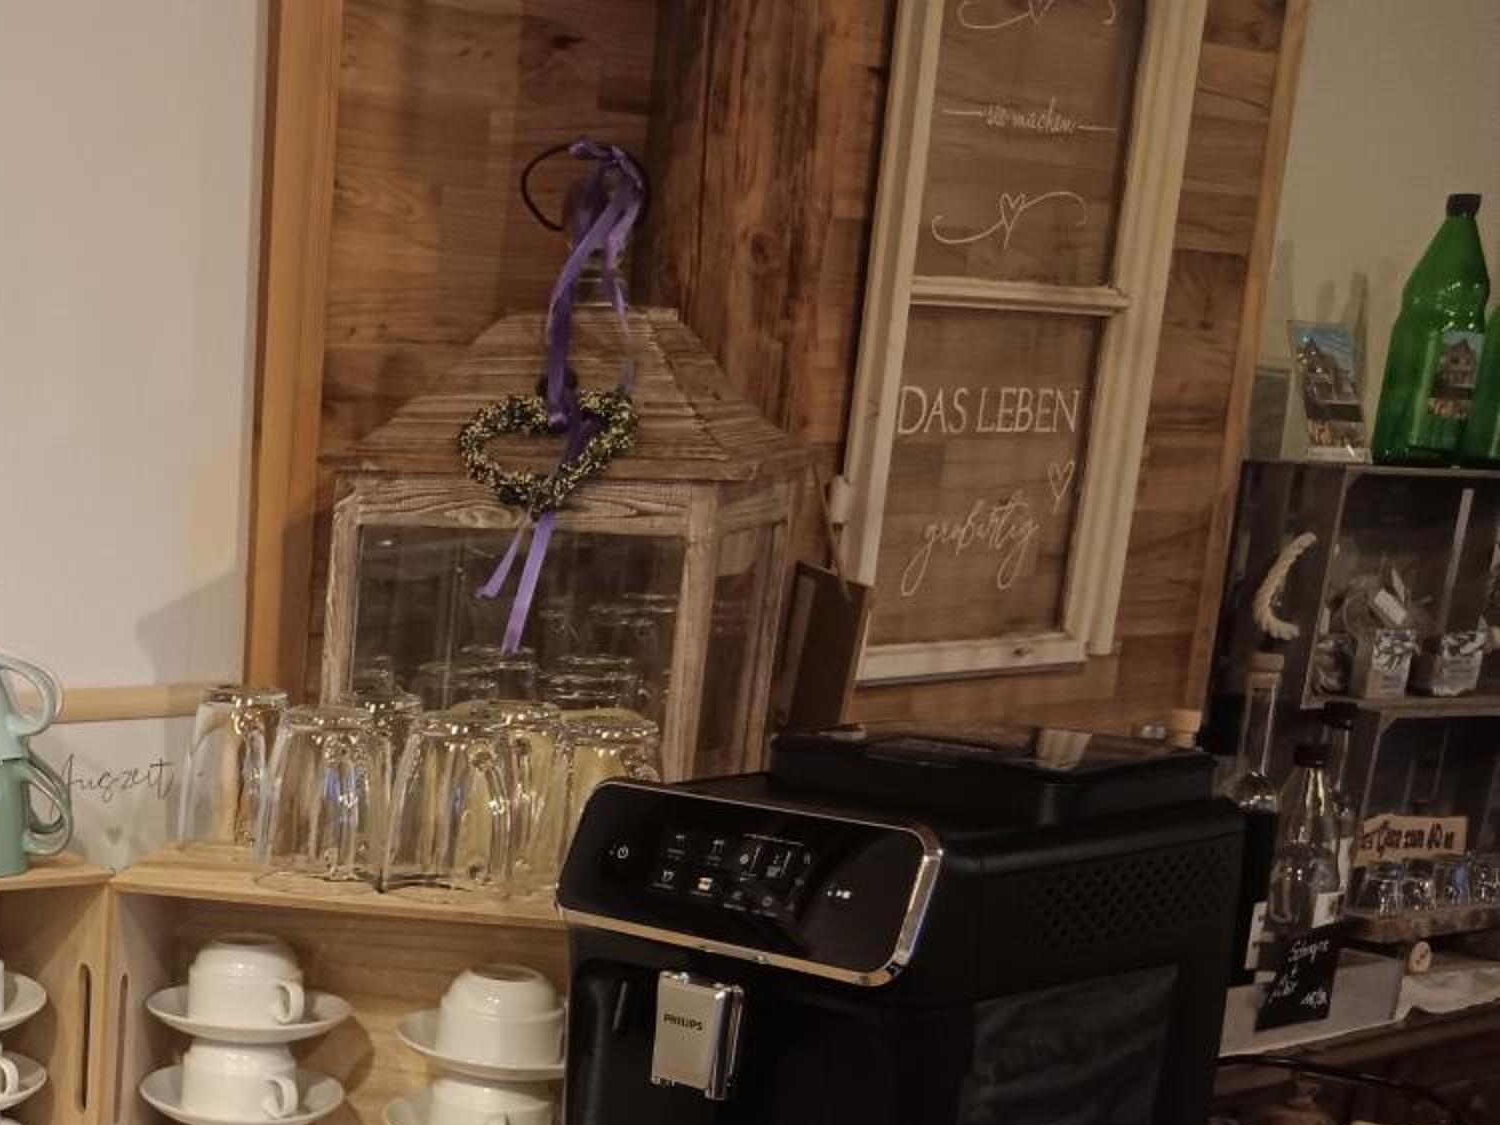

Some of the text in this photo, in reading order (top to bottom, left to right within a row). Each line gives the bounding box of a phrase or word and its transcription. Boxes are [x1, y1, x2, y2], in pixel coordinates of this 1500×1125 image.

[897, 384, 1083, 435] DAS LEBEN
[663, 1012, 703, 1031] PHILIPS
